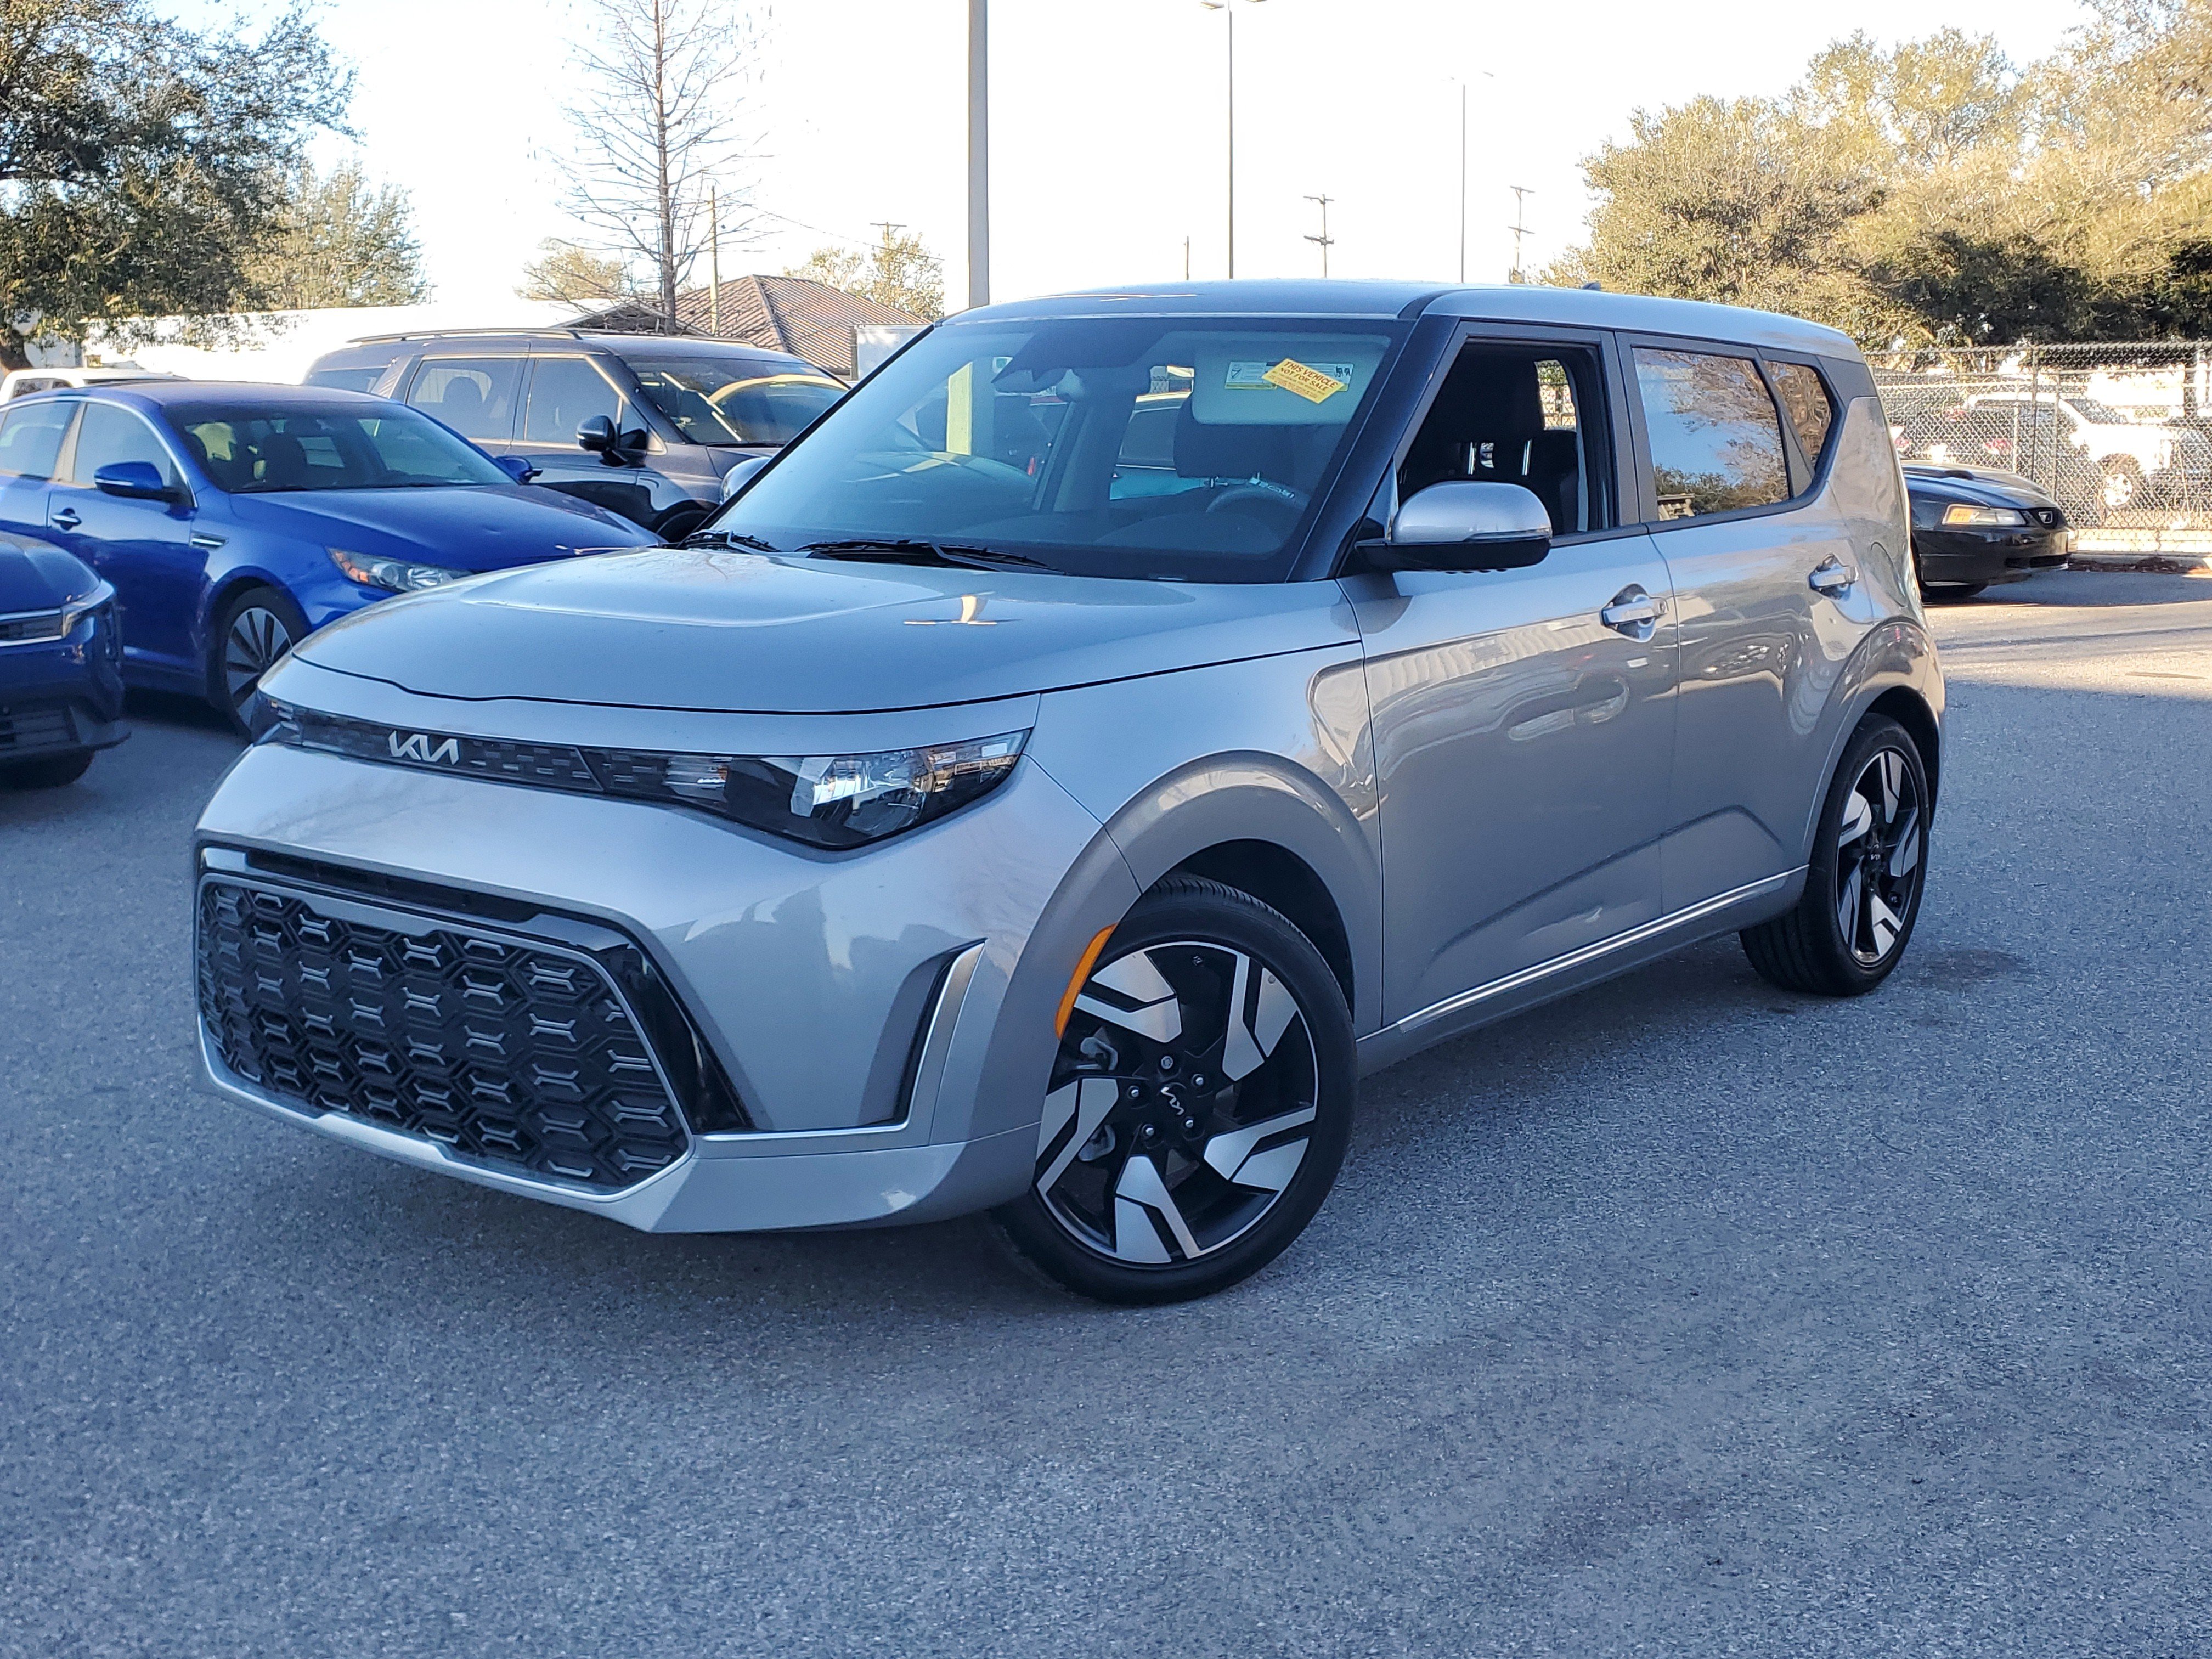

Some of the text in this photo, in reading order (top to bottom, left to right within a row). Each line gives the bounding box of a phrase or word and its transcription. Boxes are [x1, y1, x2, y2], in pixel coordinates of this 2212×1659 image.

[1280, 367, 1295, 376] NOT
[1294, 374, 1310, 382] FOR
[1310, 381, 1329, 391] SALE
[1284, 362, 1304, 373] THIS
[1303, 369, 1338, 388] VEHICLE
[388, 730, 460, 765] KIA
